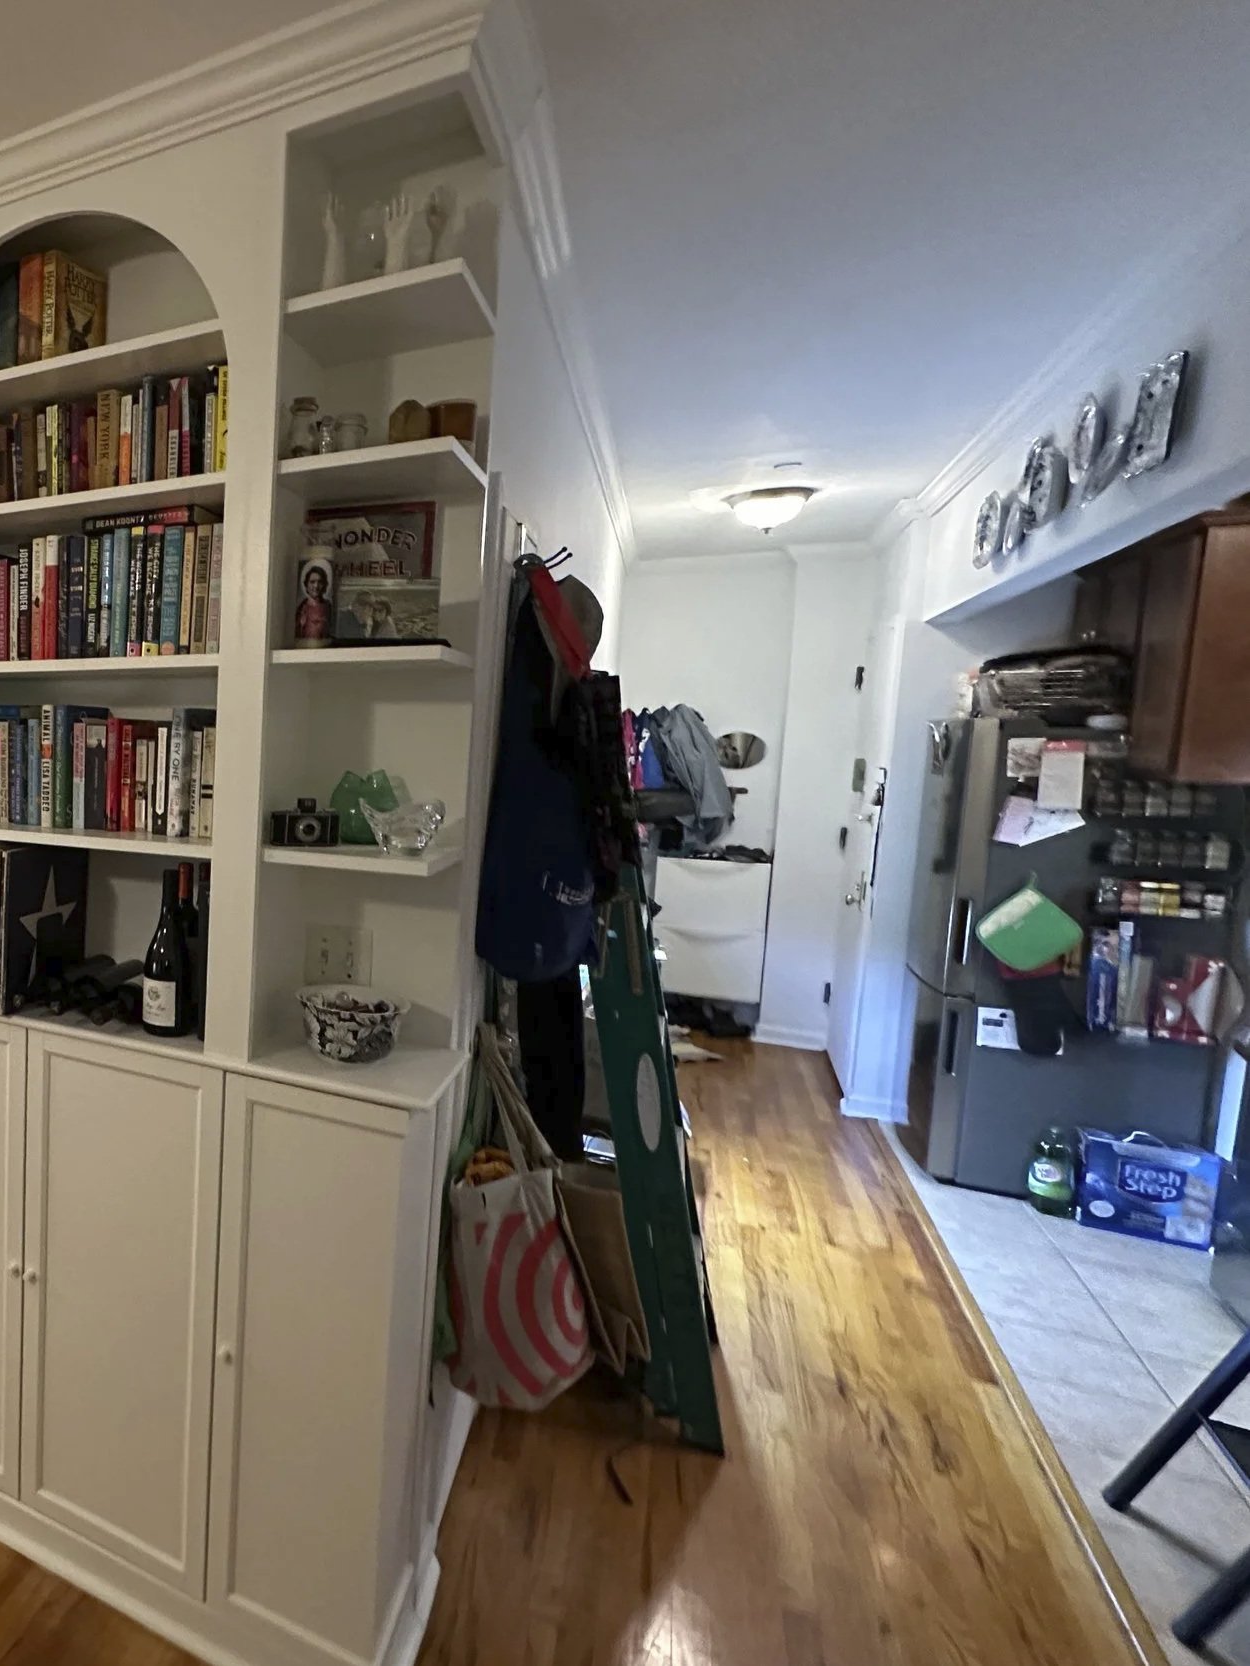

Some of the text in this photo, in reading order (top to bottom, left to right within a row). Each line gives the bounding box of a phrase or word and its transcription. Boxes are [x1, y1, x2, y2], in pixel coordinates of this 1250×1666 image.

[64, 276, 94, 304] POTTER
[45, 303, 54, 335] POTTER
[101, 394, 111, 461] NEW YORK
[96, 520, 115, 528] DEAN
[116, 516, 144, 525] KOONTZ
[19, 549, 28, 579] JOSEPH
[131, 560, 135, 572] WE
[148, 547, 153, 560] WE
[19, 581, 28, 611] FINDER
[87, 539, 98, 642] STRANGE SALLY DIAMOND LIZ NUGENT
[174, 742, 181, 755] BY
[172, 758, 180, 781] ONE
[42, 782, 50, 812] TADDEO
[1125, 1165, 1181, 1187] Fresh
[1124, 1178, 1177, 1200] Step
